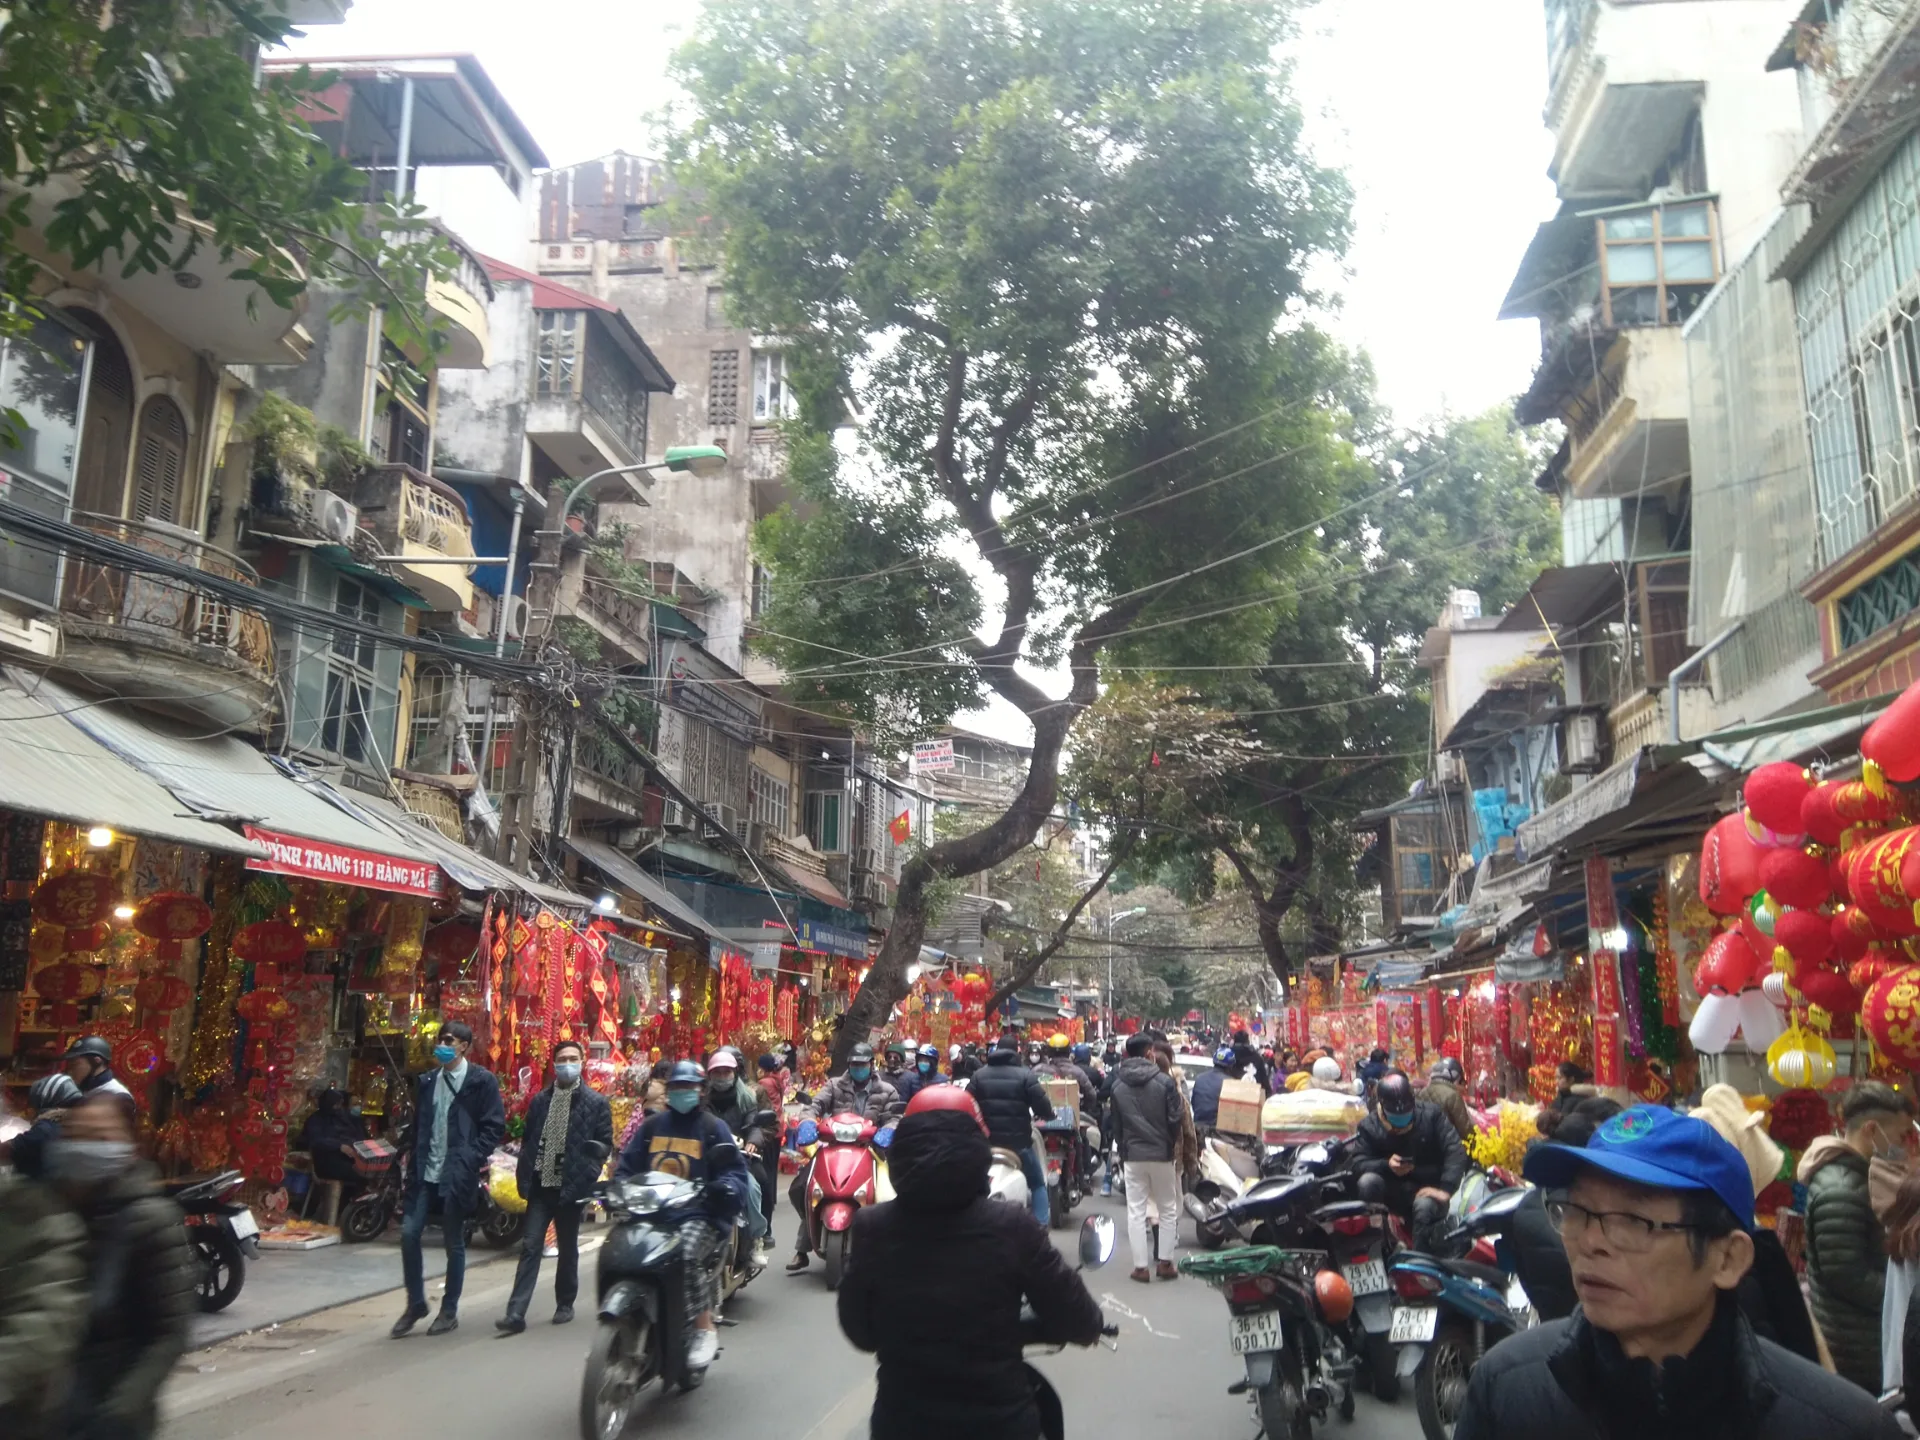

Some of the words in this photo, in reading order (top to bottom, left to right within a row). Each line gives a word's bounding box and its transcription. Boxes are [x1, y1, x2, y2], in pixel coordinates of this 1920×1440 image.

[305, 850, 350, 876] TRANG
[353, 859, 373, 879] 11B
[375, 860, 409, 885] HÀNG
[409, 867, 426, 889] MÃ
[1349, 1262, 1378, 1279] 29-B1
[1236, 1315, 1271, 1334] 36-G1
[1398, 1310, 1429, 1324] 29-C1
[1235, 1331, 1277, 1351] 030.17
